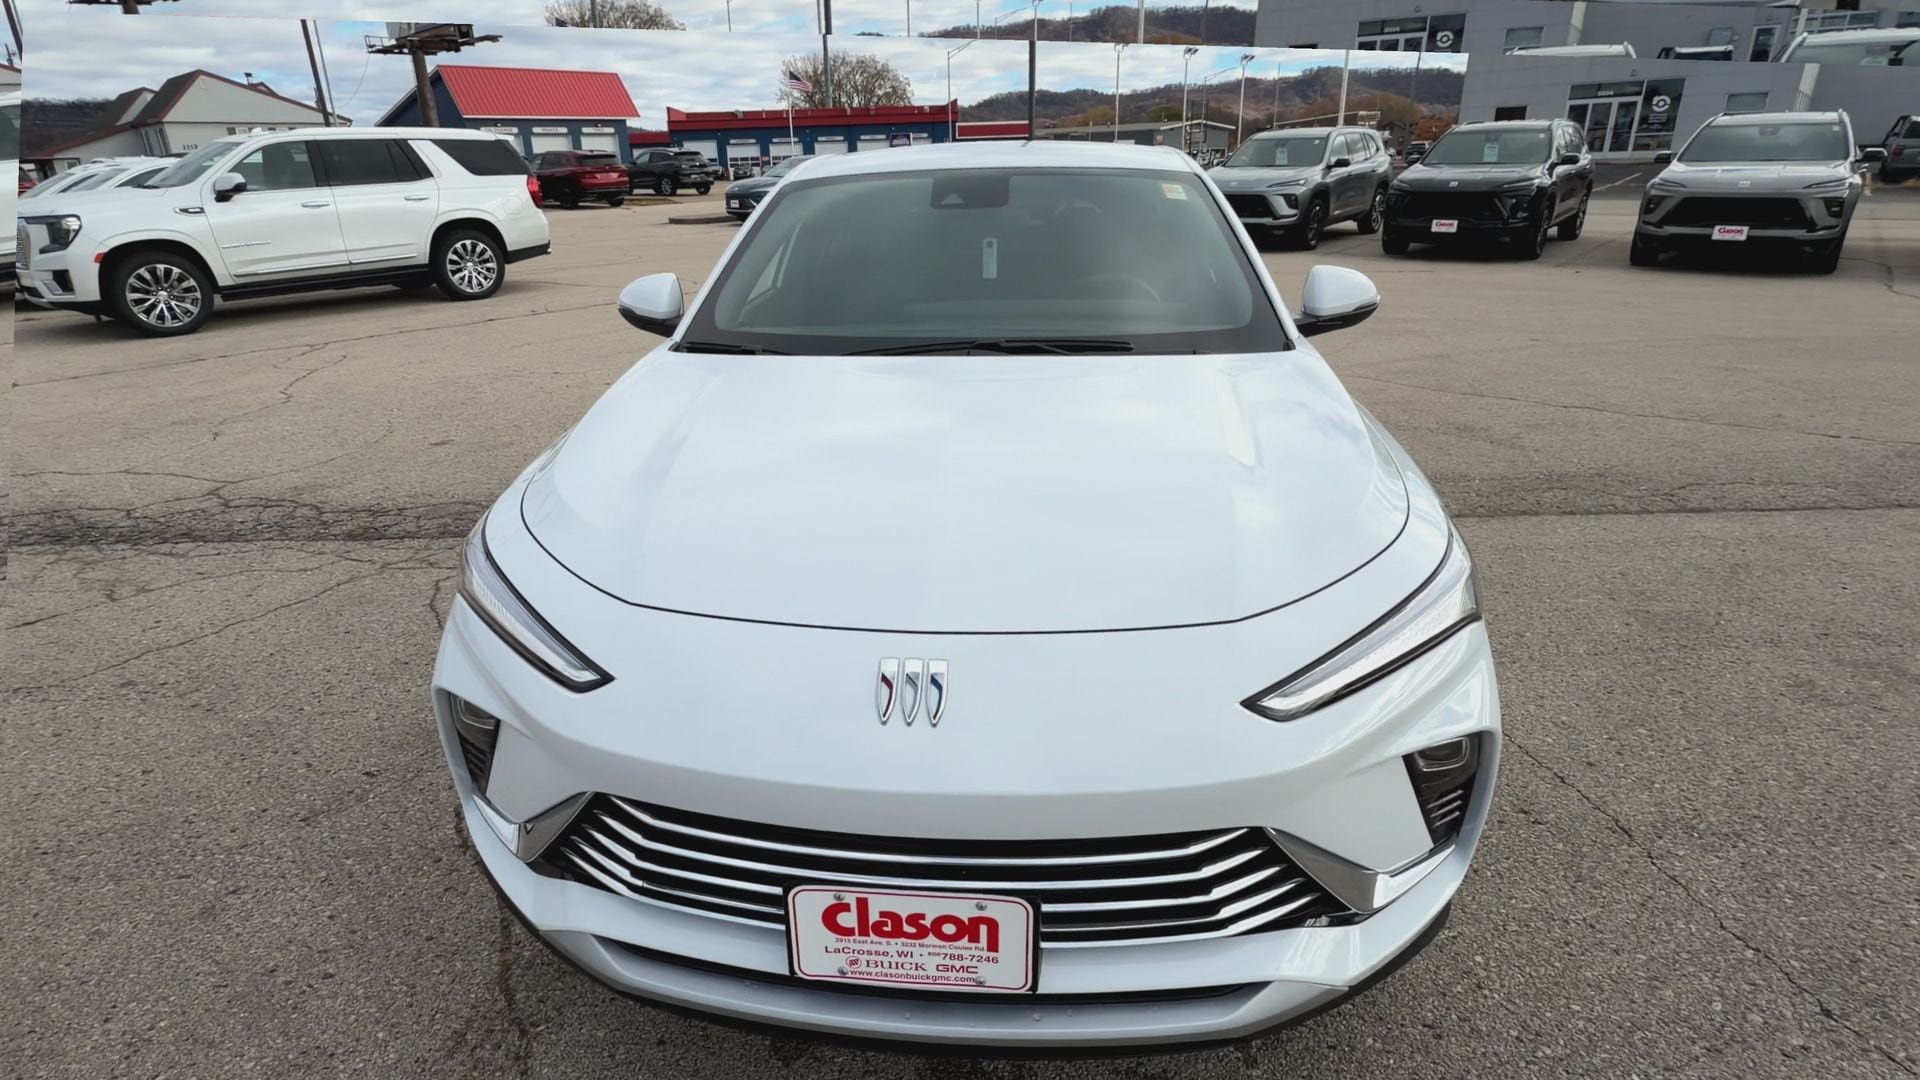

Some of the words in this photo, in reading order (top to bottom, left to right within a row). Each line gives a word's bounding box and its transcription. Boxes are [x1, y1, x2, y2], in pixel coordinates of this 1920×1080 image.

[1718, 226, 1744, 236] Clason
[821, 896, 1000, 954] Clason
[824, 945, 894, 958] LaCrosse,
[896, 949, 914, 959] WI
[918, 942, 947, 950] Mormon
[865, 959, 927, 972] BUICK
[935, 963, 979, 975] GMC
[849, 968, 976, 983] www.clasonbuickgmc.com
